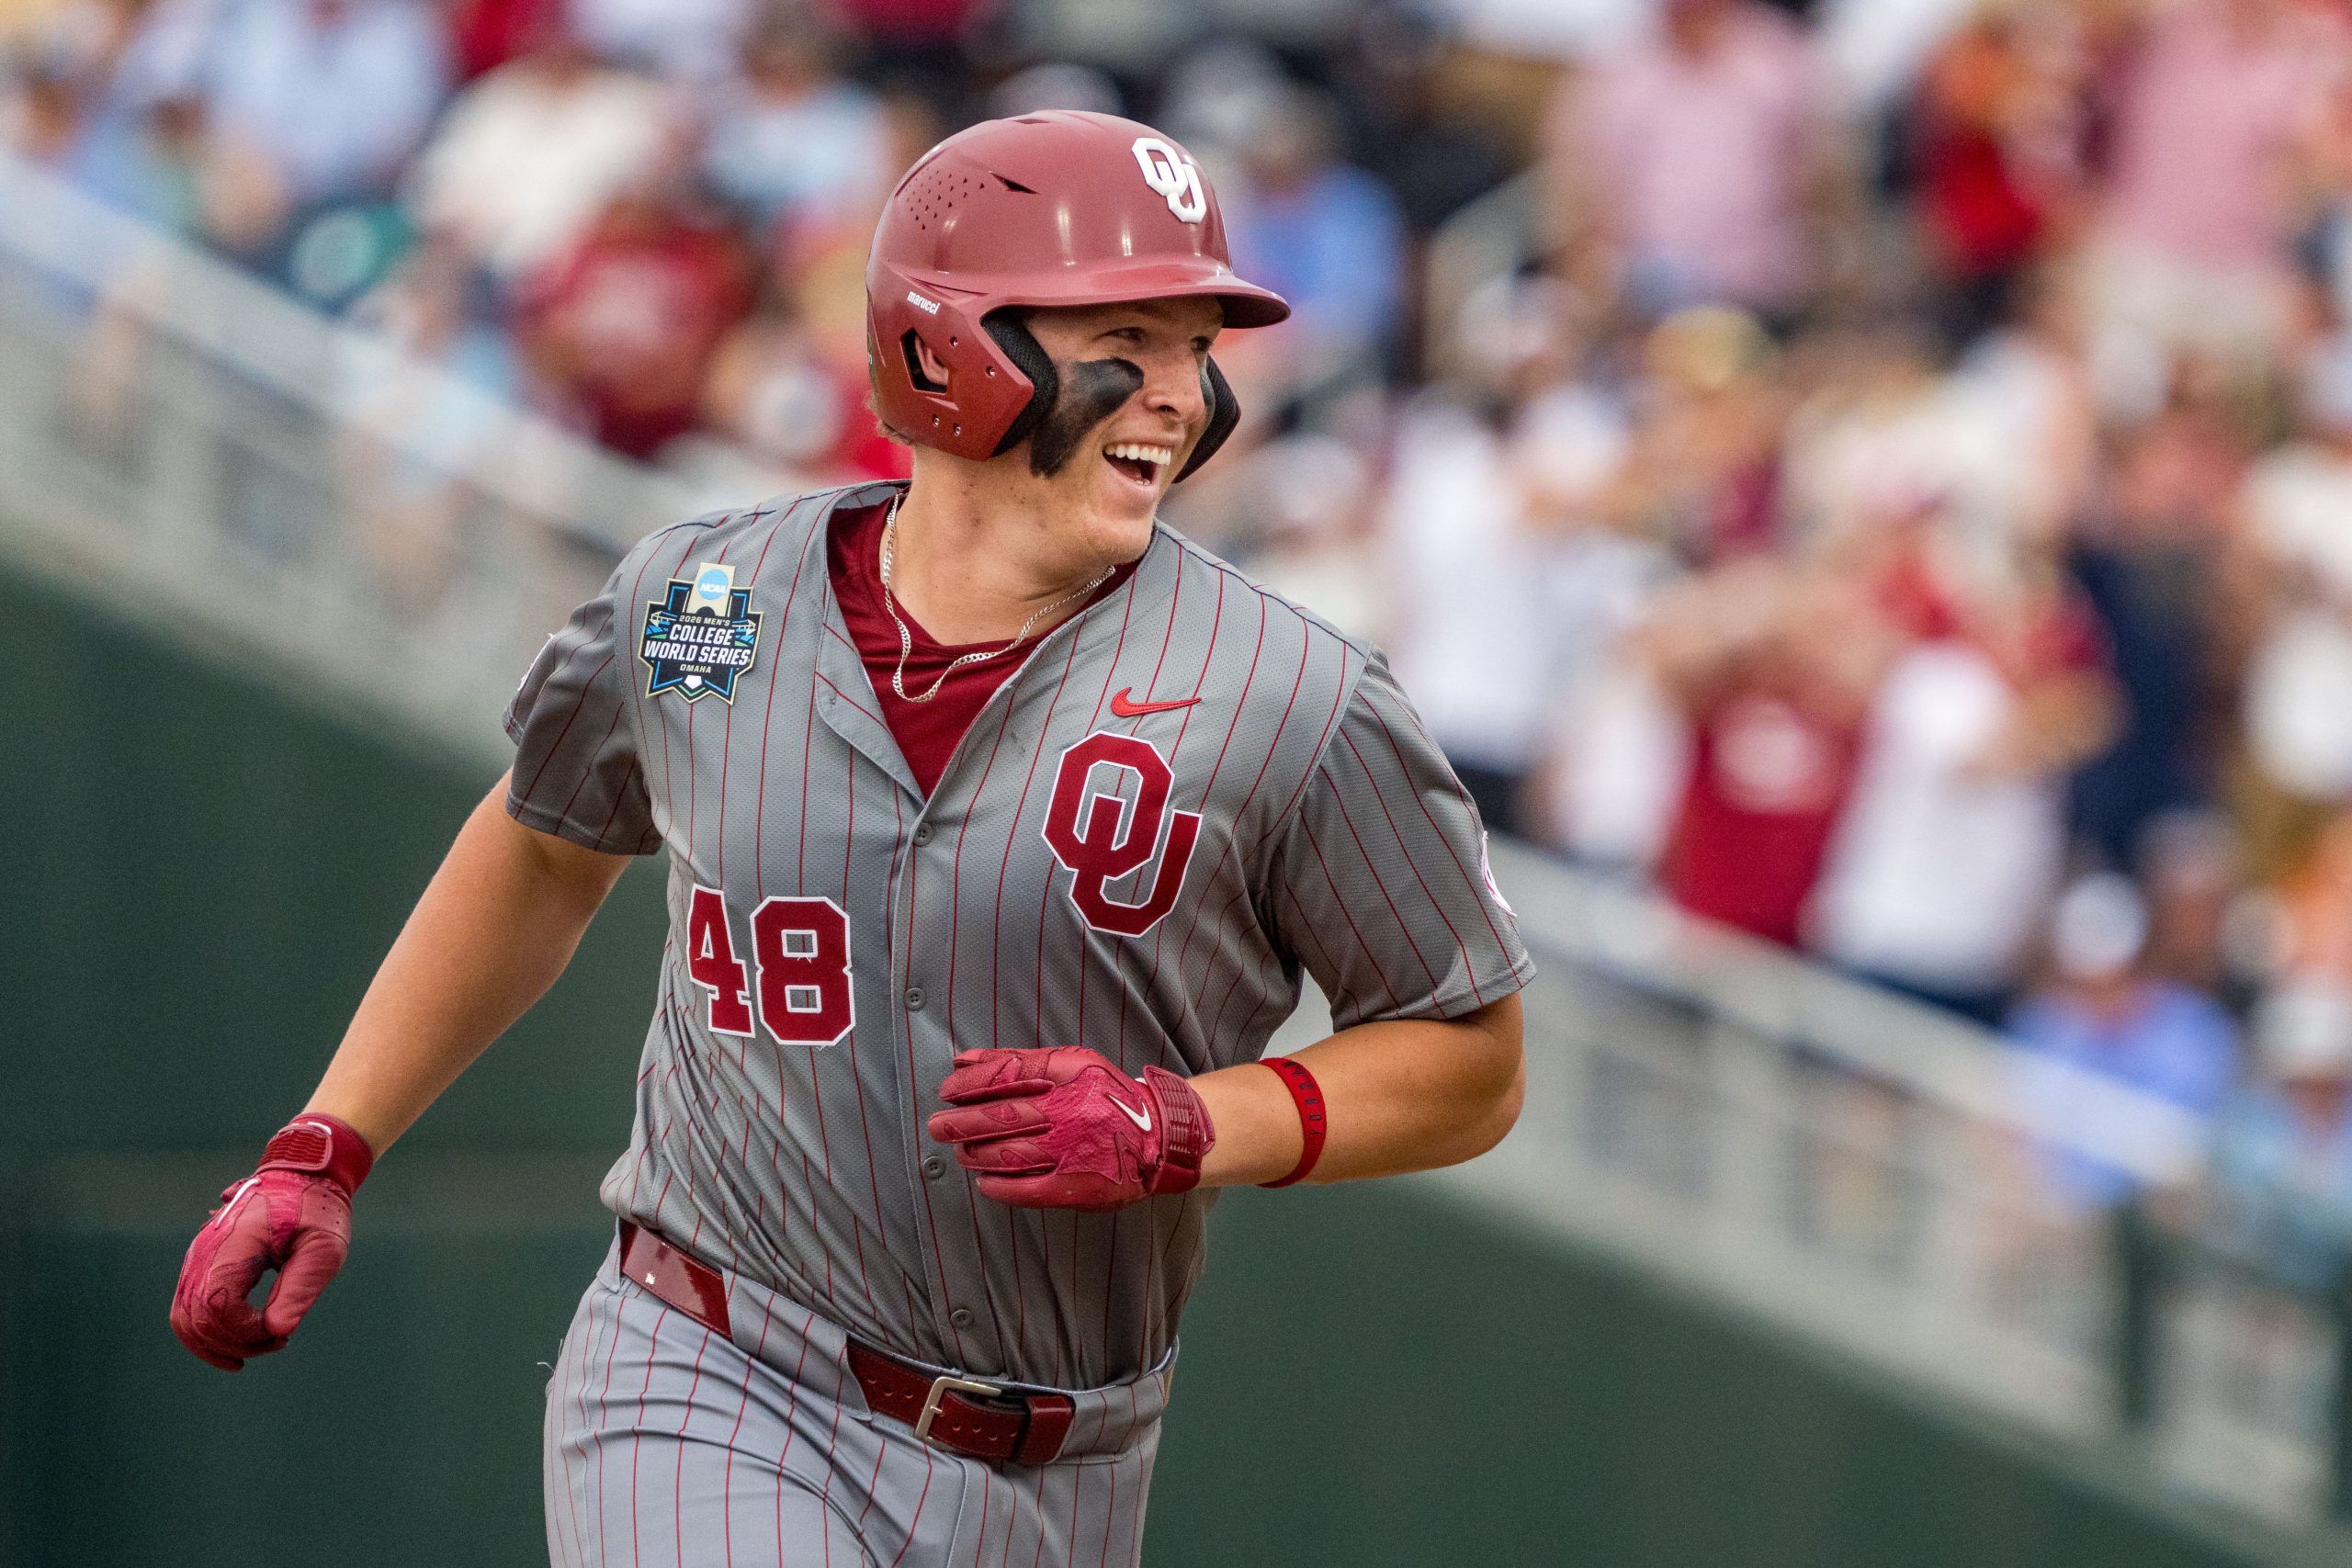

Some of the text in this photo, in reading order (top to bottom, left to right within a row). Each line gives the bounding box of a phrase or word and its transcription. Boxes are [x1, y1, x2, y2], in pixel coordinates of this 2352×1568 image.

[1131, 137, 1206, 224] OU
[907, 290, 941, 315] marucci
[679, 615, 731, 626] 2026 MEN'S
[669, 624, 735, 646] COLLEGE
[644, 640, 751, 666] WORLD SERIES
[679, 663, 712, 673] OMAHA
[1041, 729, 1204, 939] OU
[686, 883, 856, 1046] 48
